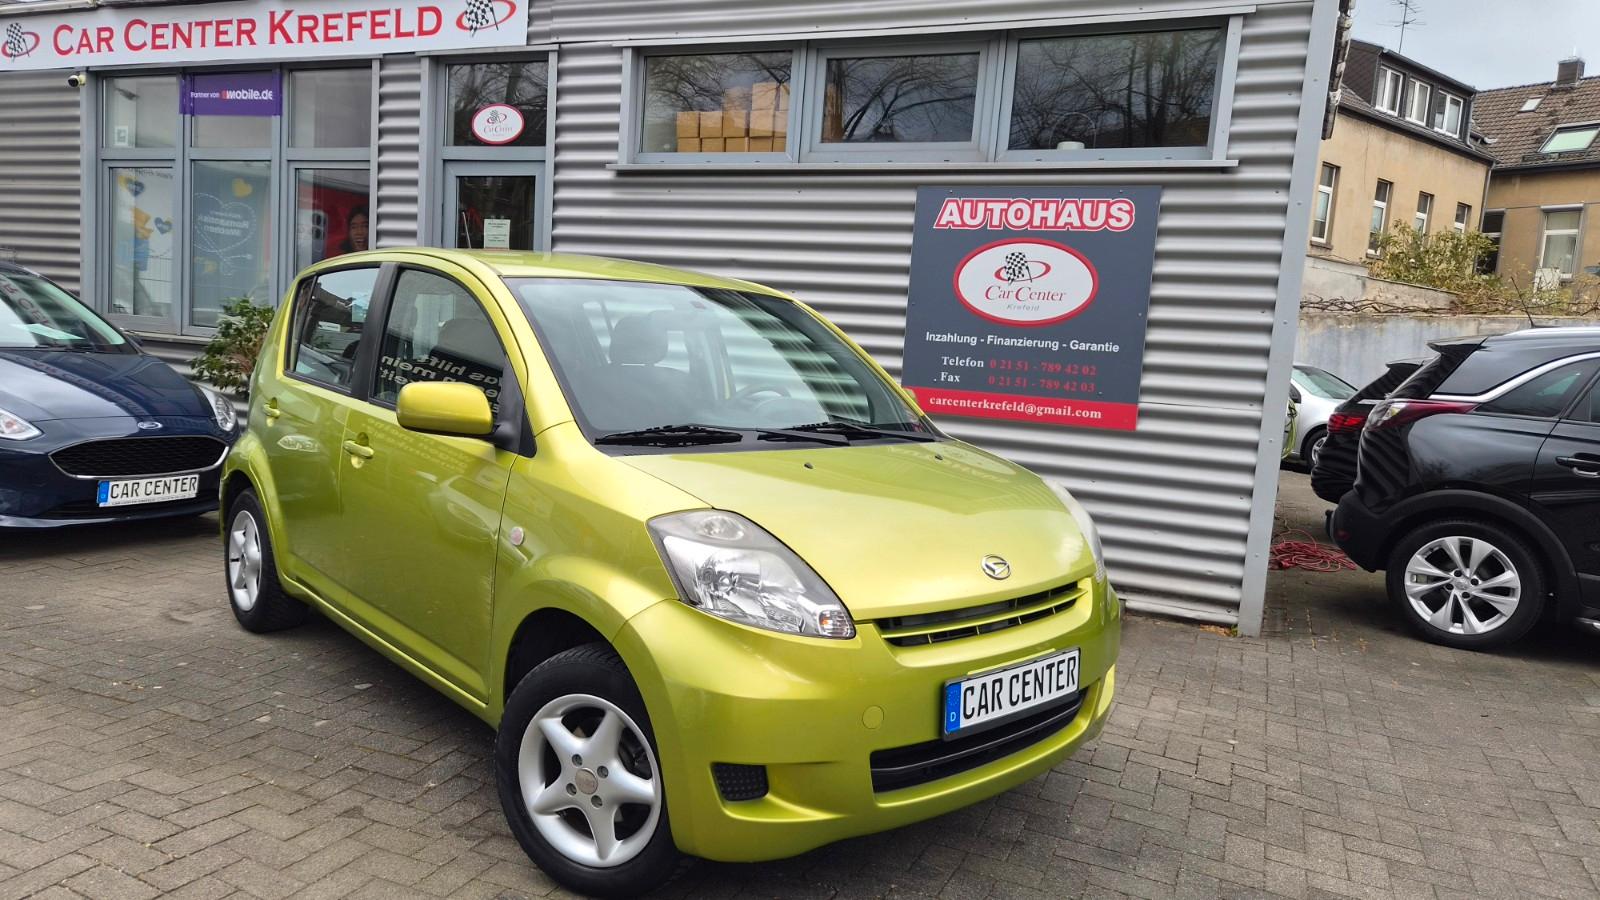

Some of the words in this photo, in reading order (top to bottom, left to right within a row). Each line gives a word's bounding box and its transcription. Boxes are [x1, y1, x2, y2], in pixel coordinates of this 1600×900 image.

[53, 24, 114, 56] CAR
[124, 18, 257, 52] CENTER
[268, 5, 442, 45] KREFELD
[933, 198, 1135, 232] AUTOHAUS
[985, 284, 1013, 301] Car
[1014, 286, 1067, 302] Center
[926, 331, 977, 346] Inzahlung
[987, 335, 1059, 351] Finanzierung
[1069, 340, 1120, 353] Garantie
[941, 356, 984, 368] Telefon
[990, 359, 996, 369] 0
[1000, 360, 1011, 369] 21
[1016, 361, 1028, 371] 51
[1041, 362, 1061, 373] 789
[1064, 364, 1078, 375] 42
[1082, 365, 1096, 376] 02
[940, 371, 961, 382] Fax
[989, 375, 995, 385] 0
[999, 376, 1010, 386] 21
[1014, 377, 1027, 387] 51
[1040, 379, 1060, 390] 789
[1063, 381, 1077, 391] 42
[929, 397, 1102, 419] carcenterkrefeld@gmail.com
[110, 482, 140, 499] CAR
[145, 476, 197, 496] CENTER
[950, 711, 956, 722] D
[962, 677, 1003, 719] CAR
[1009, 655, 1077, 706] CENTER
